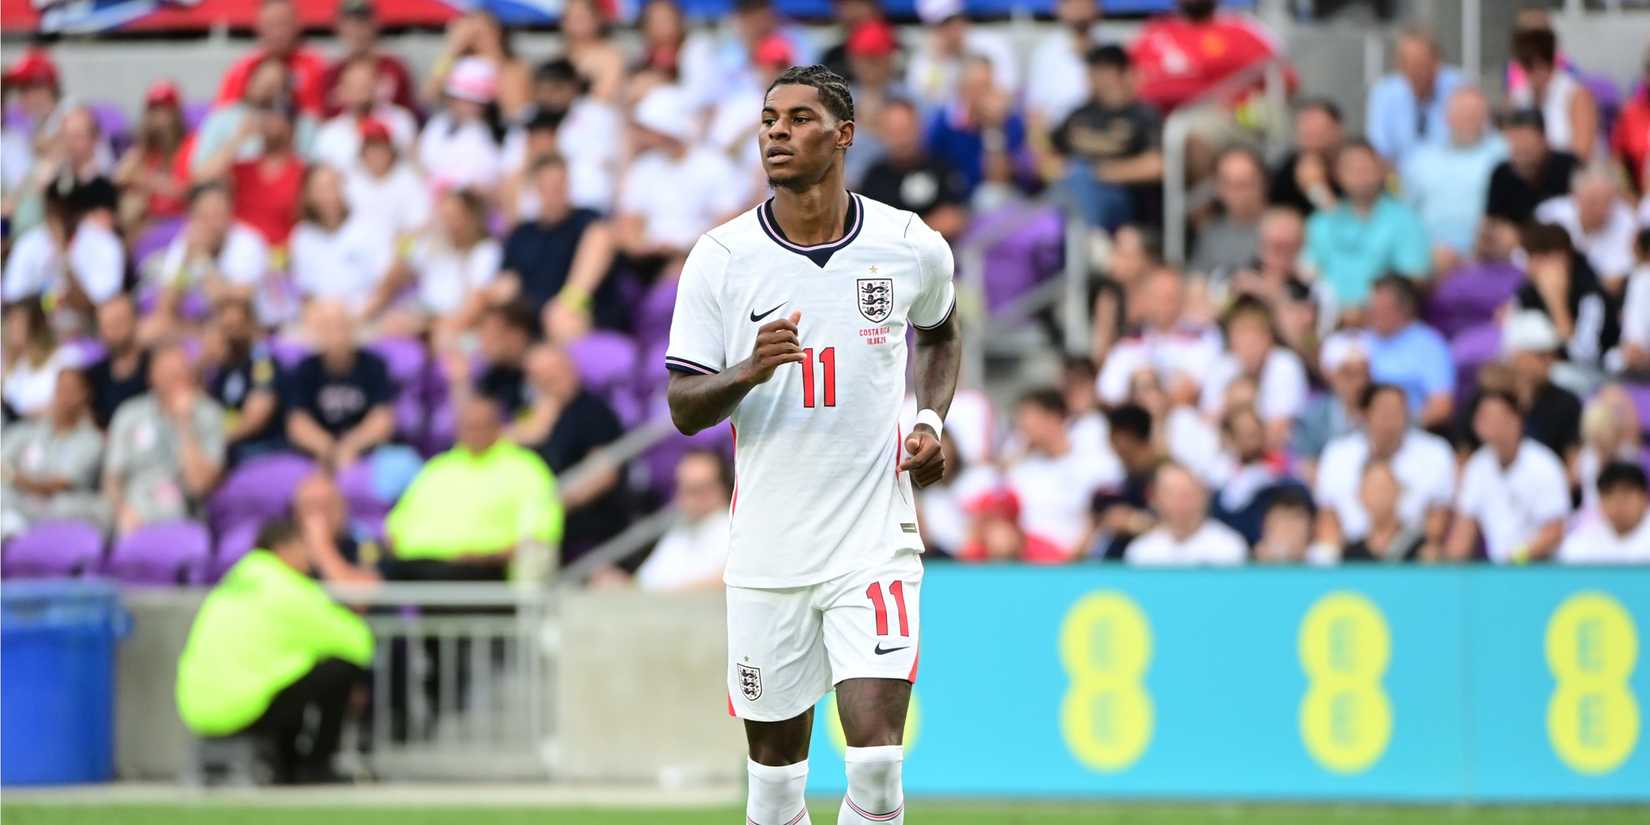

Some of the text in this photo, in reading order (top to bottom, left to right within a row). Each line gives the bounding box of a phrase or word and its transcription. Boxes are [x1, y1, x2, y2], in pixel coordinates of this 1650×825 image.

[859, 328, 880, 337] COSTA
[798, 347, 836, 408] 11
[866, 580, 910, 637] 11
